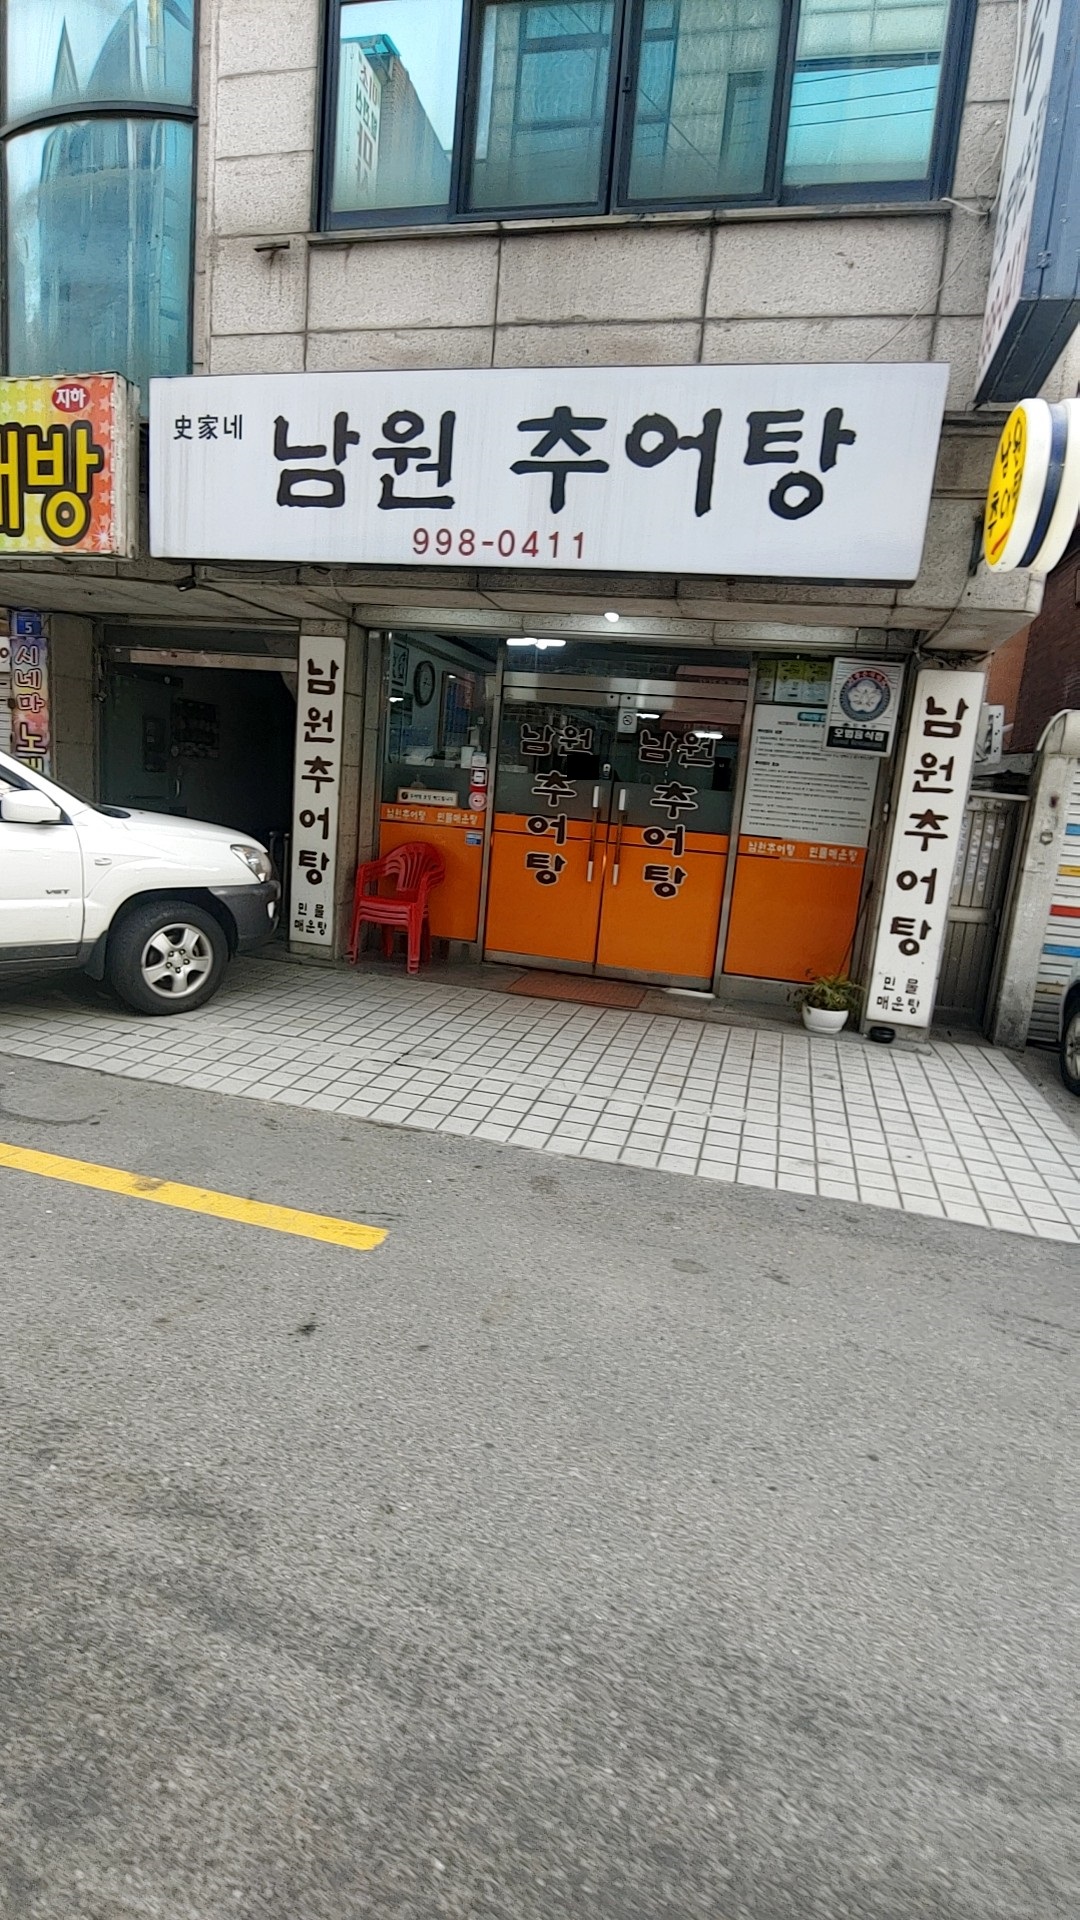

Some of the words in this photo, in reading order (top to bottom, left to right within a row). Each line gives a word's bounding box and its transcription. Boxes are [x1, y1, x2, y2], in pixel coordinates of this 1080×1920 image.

[56, 388, 86, 408] 지하
[173, 414, 244, 441] 史家네
[273, 410, 457, 511] 남원
[510, 406, 858, 521] 추어탕
[412, 527, 584, 560] 998-0411
[25, 621, 34, 635] 5
[15, 646, 45, 713] 시네마
[521, 723, 593, 756] 남원
[639, 729, 716, 768] 남원
[525, 770, 578, 886] 추어탕
[642, 781, 699, 899] 추어탕
[748, 841, 796, 857] 남원추어탕
[294, 920, 327, 936] 매운탕
[877, 996, 920, 1015] 매운탕
